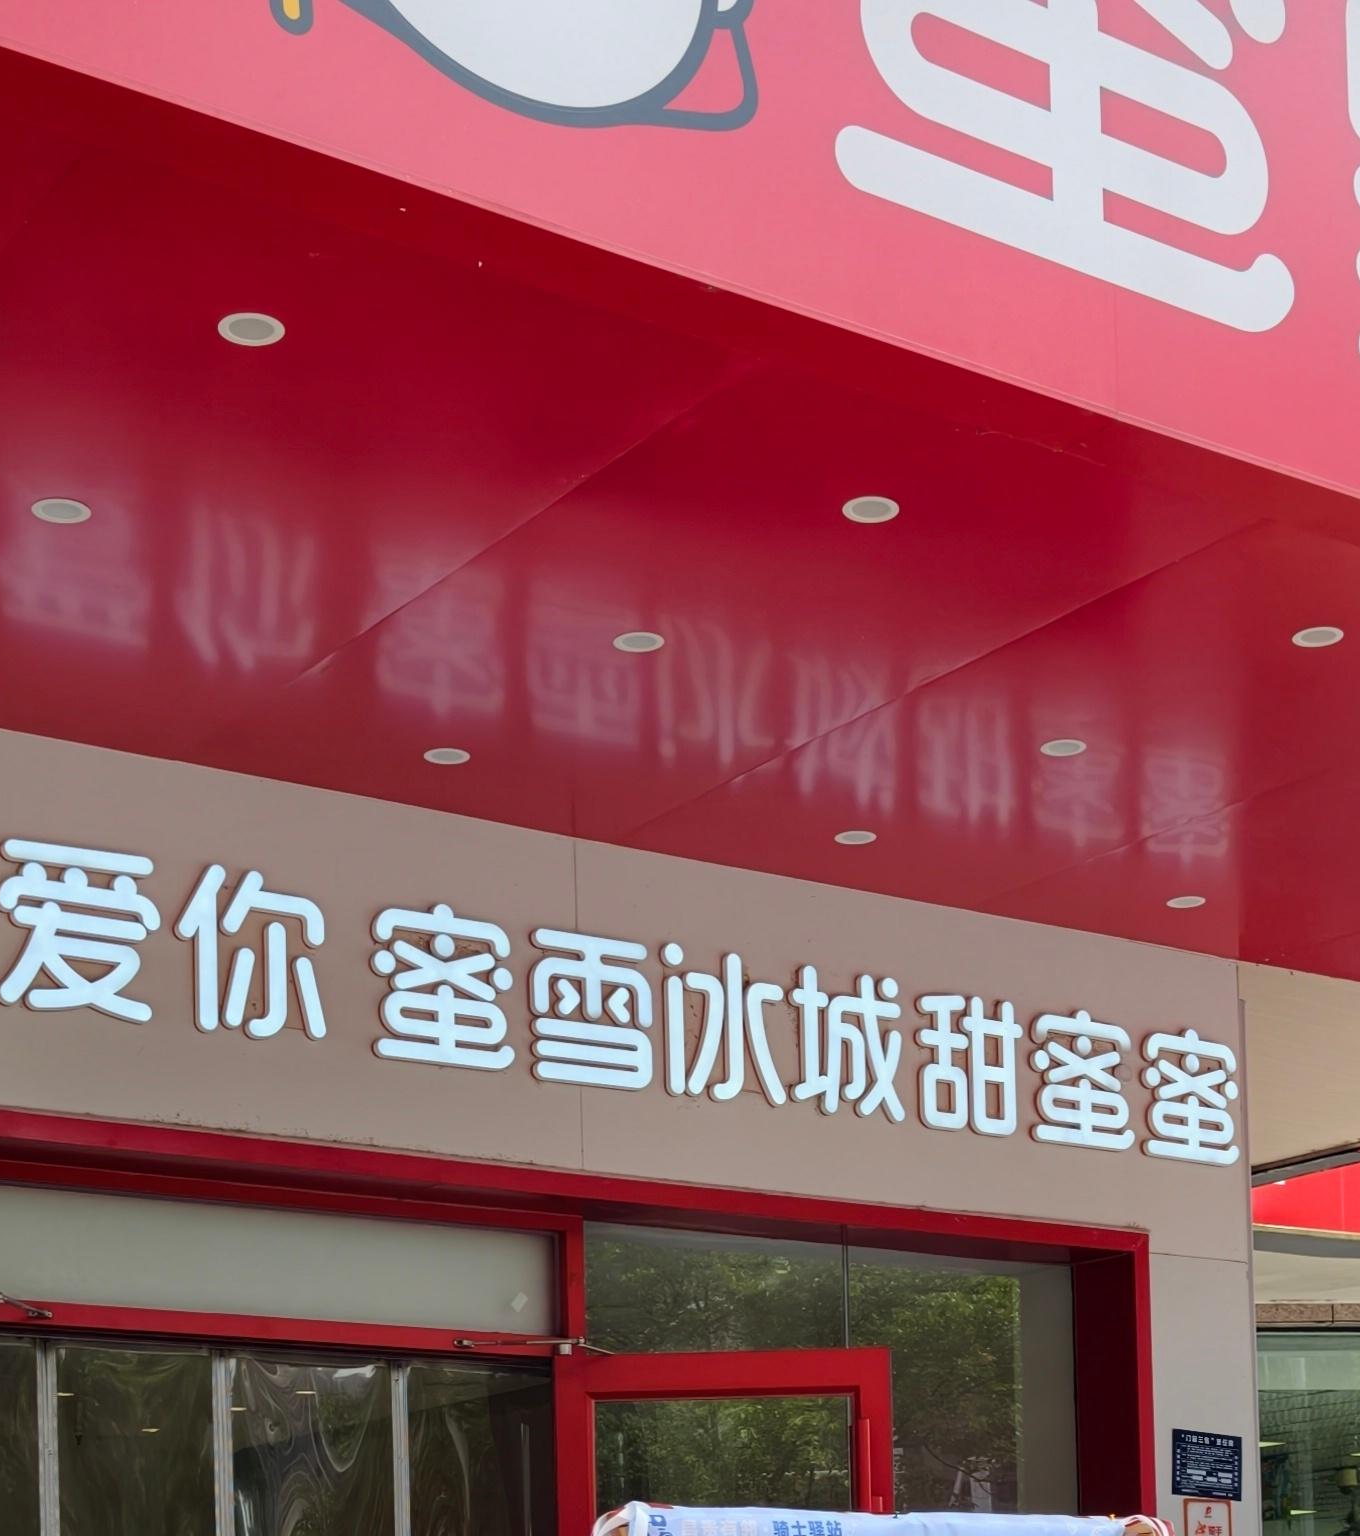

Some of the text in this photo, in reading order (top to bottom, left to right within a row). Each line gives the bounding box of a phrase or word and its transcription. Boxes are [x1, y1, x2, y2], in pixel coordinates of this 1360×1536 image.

[371, 903, 1241, 1167] 蜜雪冰城甜蜜蜜
